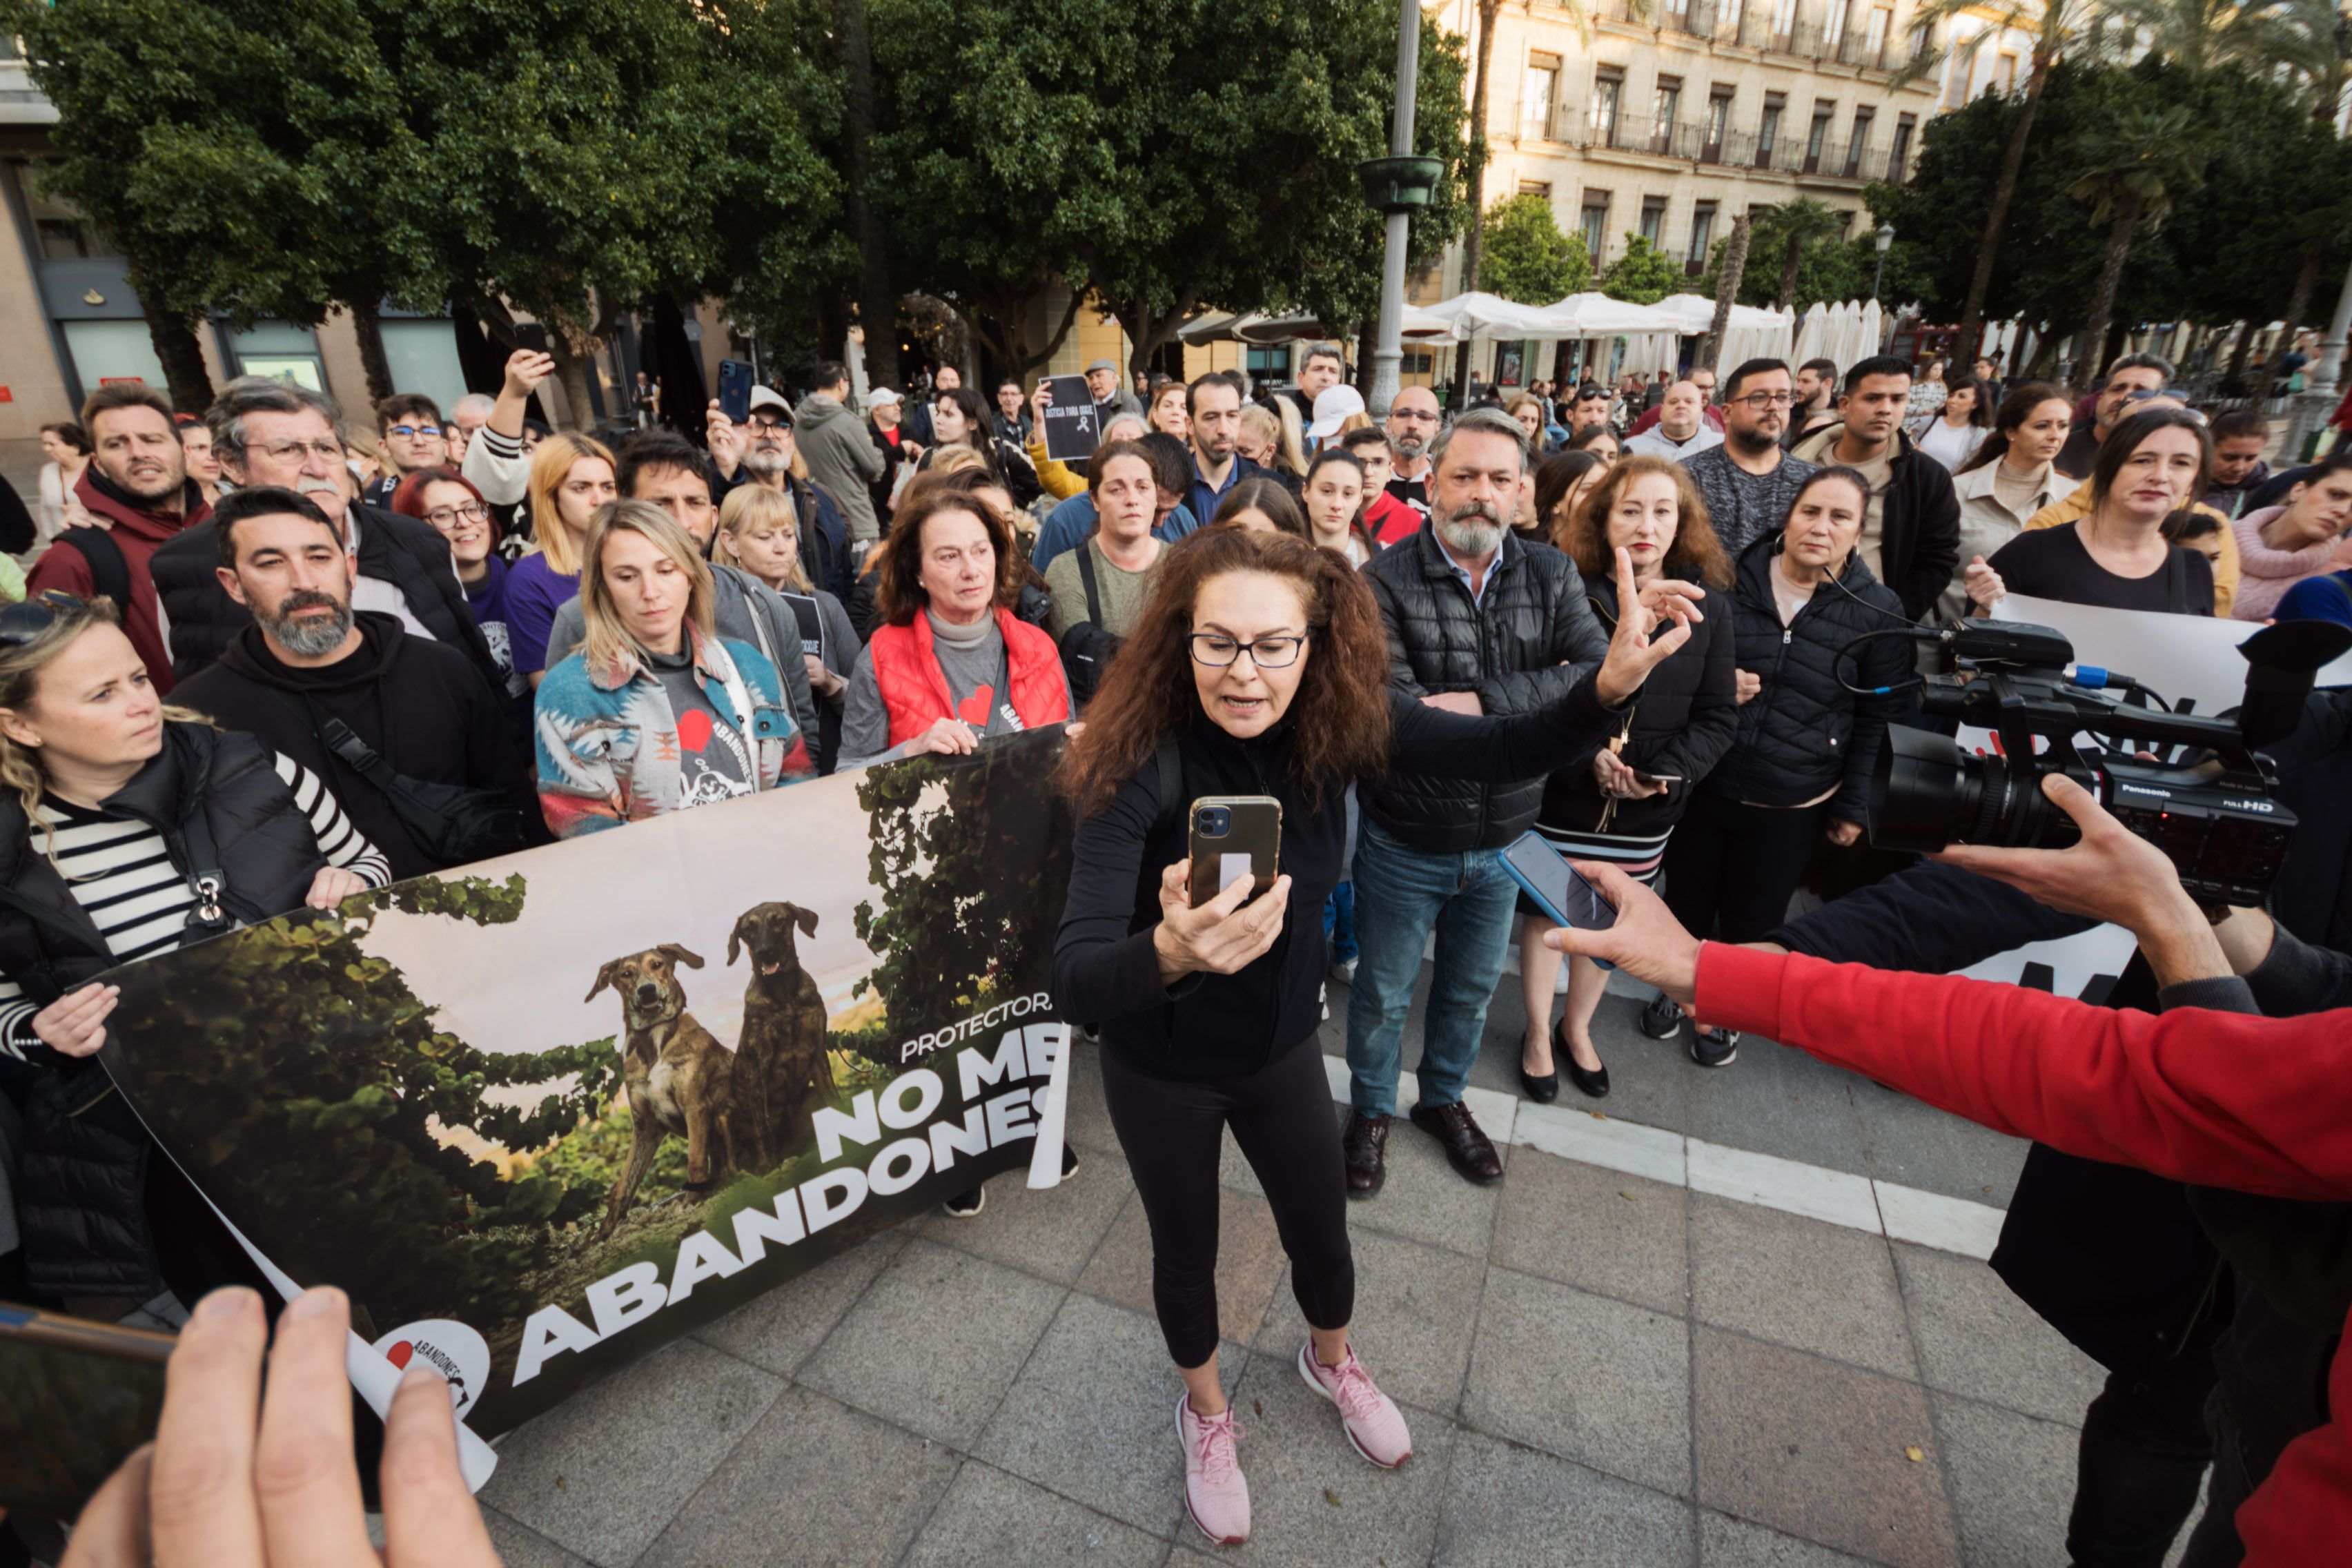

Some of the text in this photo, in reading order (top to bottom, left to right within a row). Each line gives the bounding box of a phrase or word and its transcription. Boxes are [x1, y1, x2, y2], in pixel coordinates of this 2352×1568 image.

[1066, 406, 1079, 417] PARA
[2122, 784, 2170, 798] Panasonic
[2223, 799, 2273, 812] FULL HD
[901, 992, 1052, 1064] PROTECTOR
[812, 1022, 1063, 1164] NO ME
[413, 1340, 460, 1380] ABANDONES
